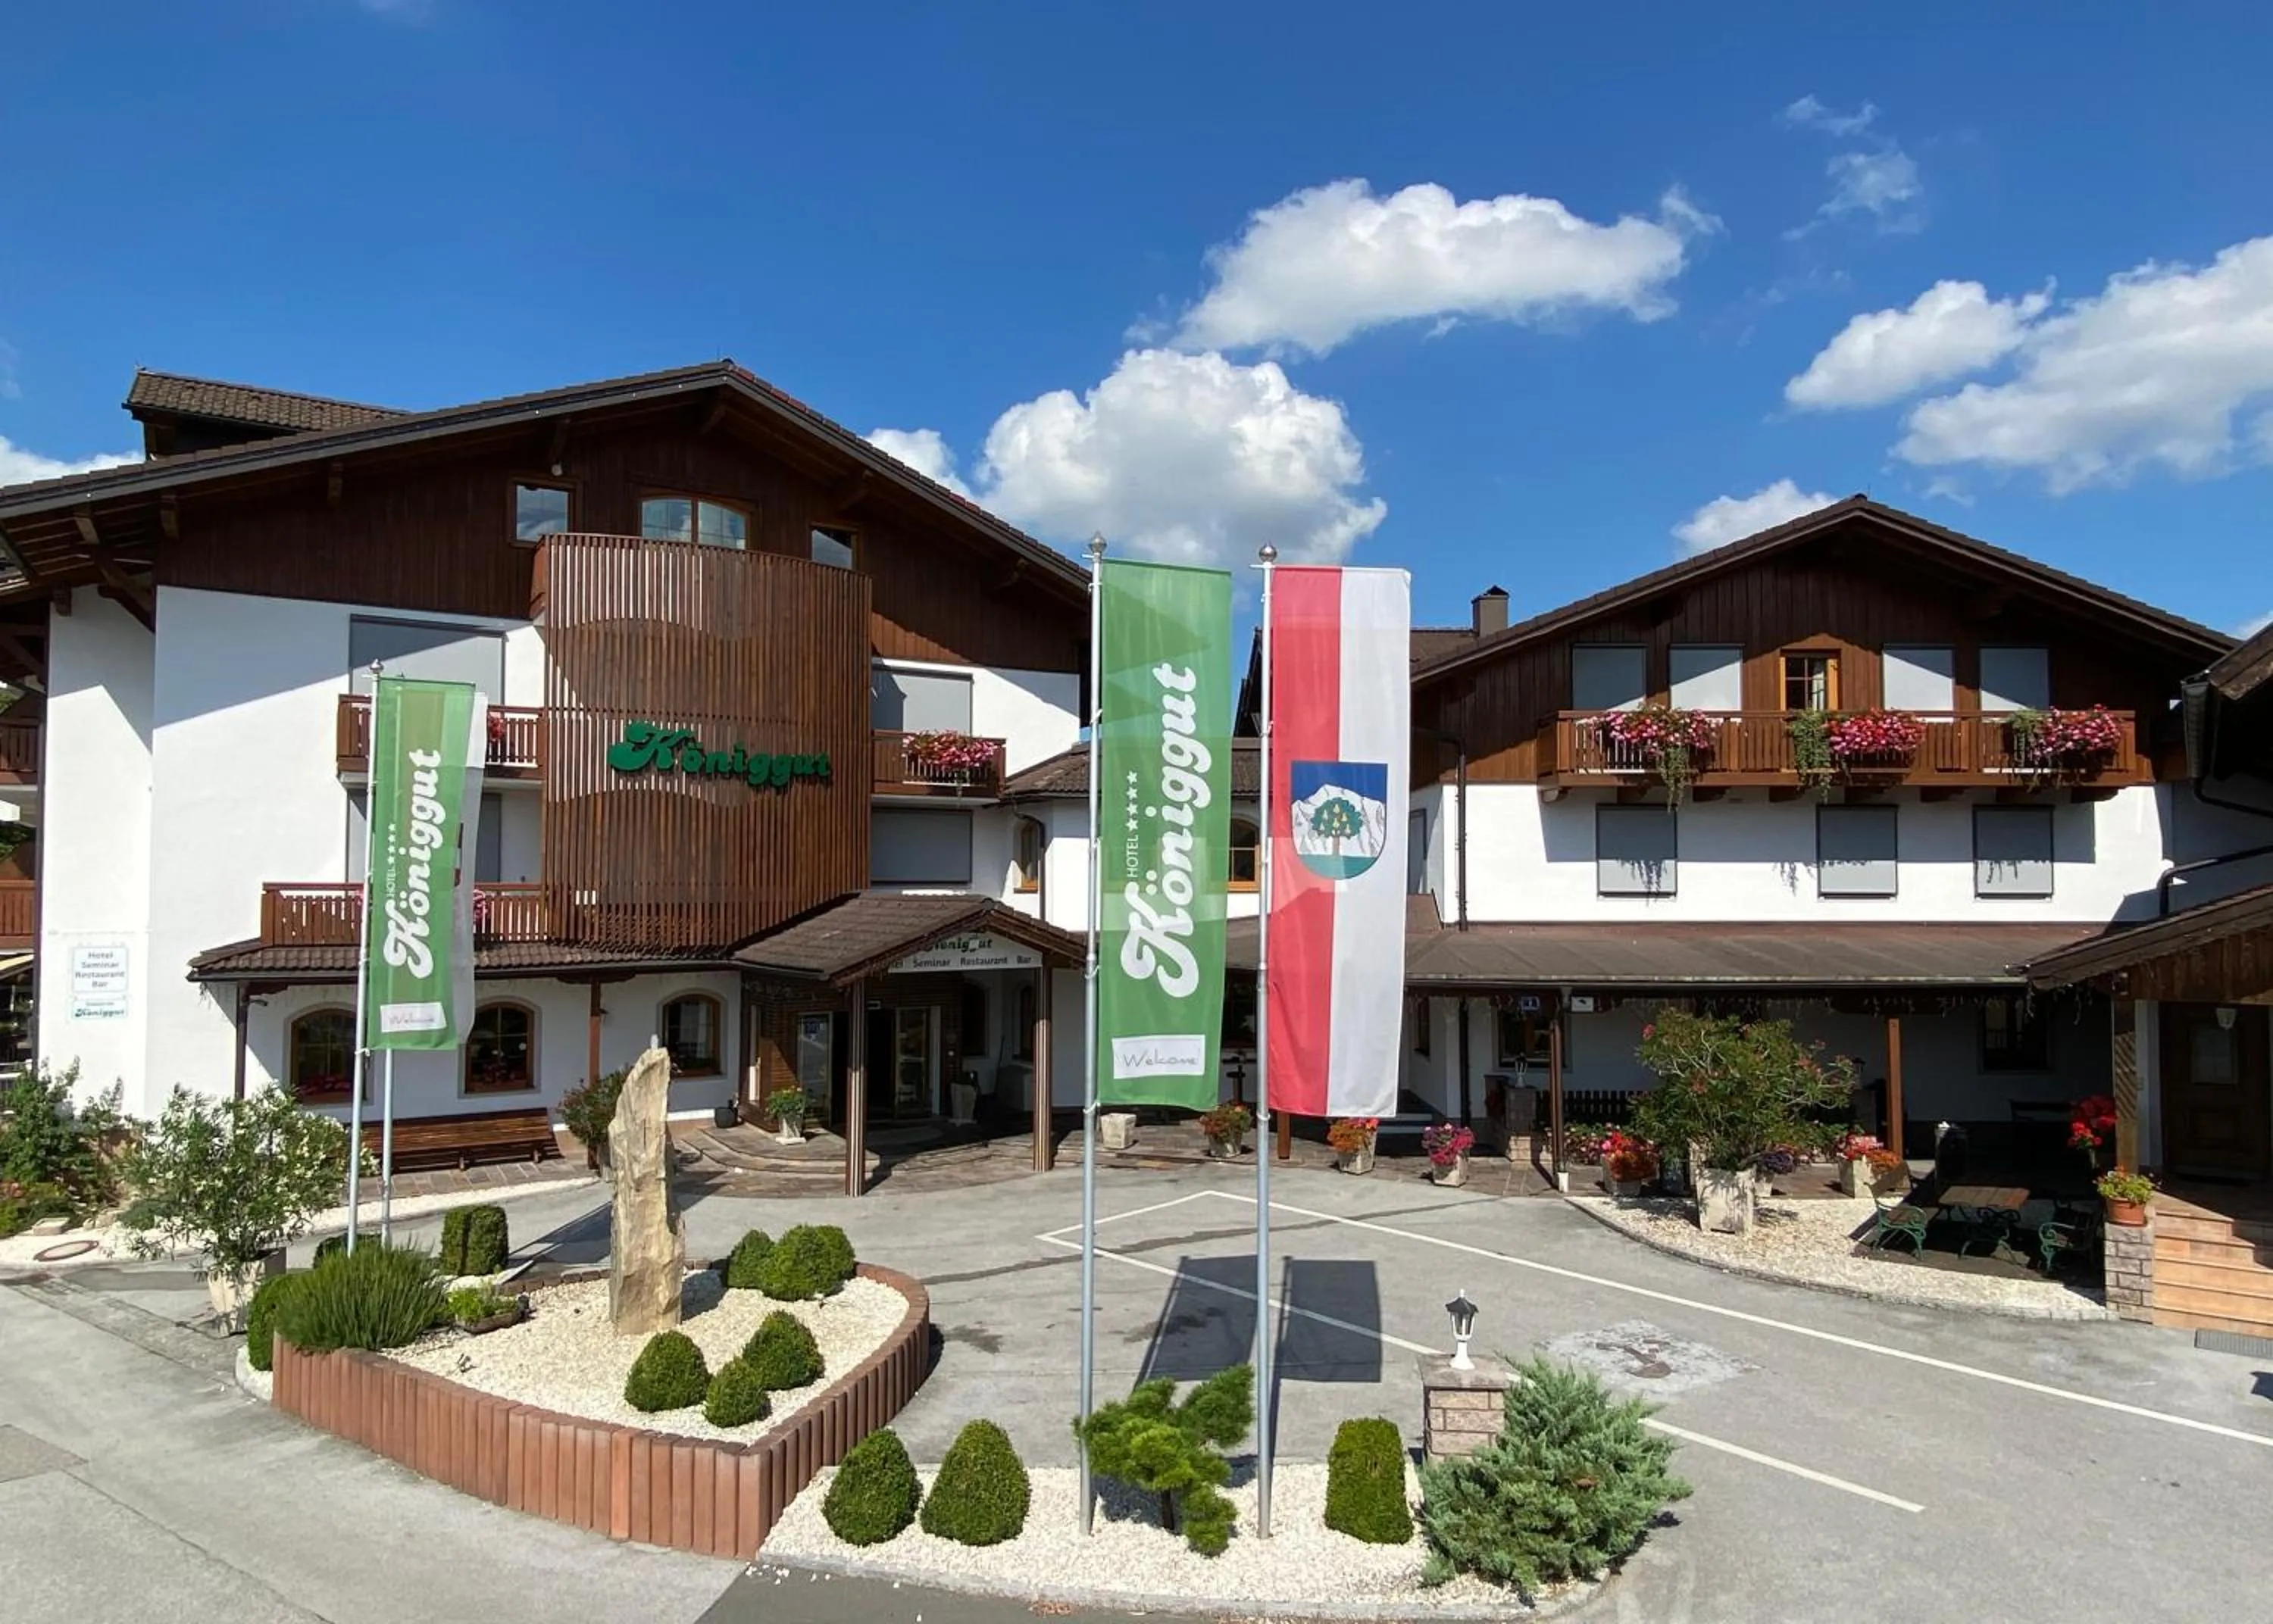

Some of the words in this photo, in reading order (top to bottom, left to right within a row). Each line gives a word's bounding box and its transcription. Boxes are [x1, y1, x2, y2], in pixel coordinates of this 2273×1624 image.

[607, 720, 831, 786] Königgut
[1121, 661, 1212, 998] Königgut
[1126, 834, 1139, 879] HOTEL
[383, 748, 446, 979] Königgut
[386, 865, 396, 898] HOTEL
[912, 957, 952, 969] Seminar
[960, 956, 1008, 967] Restaurant
[1017, 955, 1032, 964] Bar
